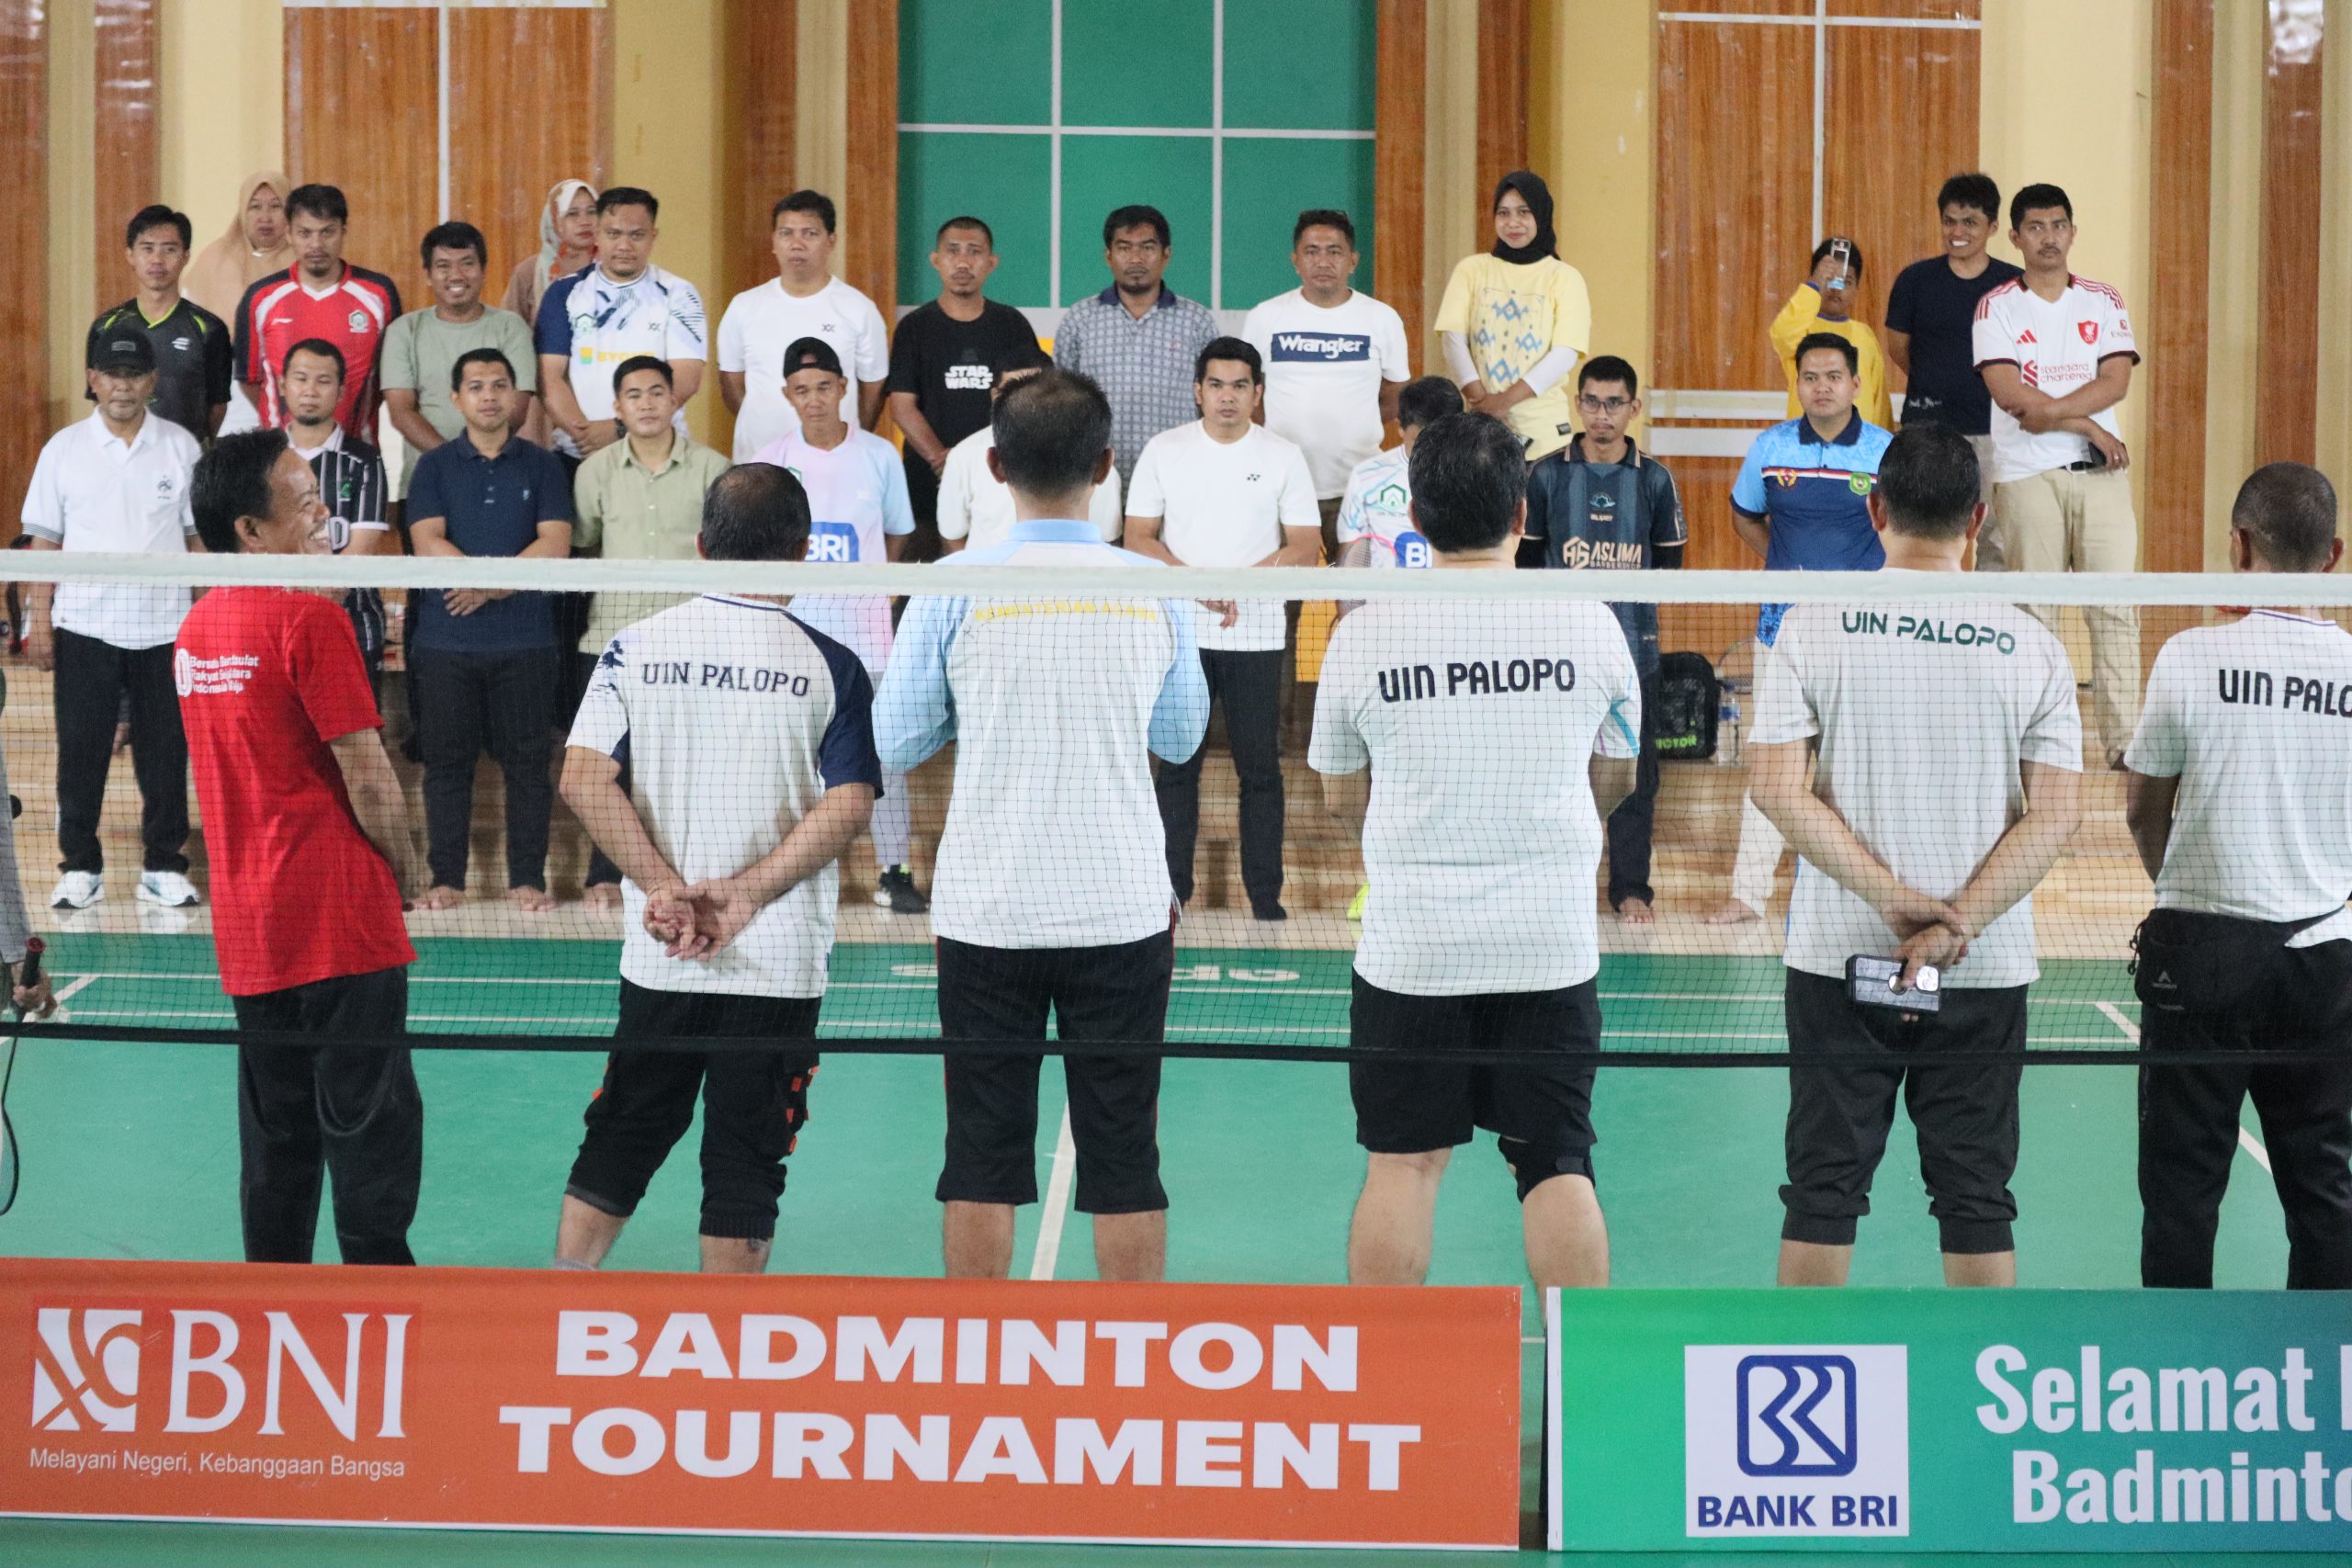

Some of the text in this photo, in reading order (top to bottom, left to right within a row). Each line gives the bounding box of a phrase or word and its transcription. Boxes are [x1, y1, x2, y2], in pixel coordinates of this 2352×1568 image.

[1277, 334, 1364, 359] Wrangler
[944, 366, 993, 378] STAR
[944, 378, 993, 389] WARS
[1590, 540, 1643, 562] ASLIMA
[1842, 611, 2016, 655] UIN PALOPO
[643, 662, 809, 696] UIN PALOPO
[1378, 659, 1576, 704] UIN PALOPO
[2219, 669, 2273, 706] UIN
[556, 1310, 1359, 1393] BADMINTON
[163, 1309, 413, 1442] BNI
[1975, 1345, 2315, 1434] Selamat
[29, 1448, 405, 1482] Melayani Negeri, Kebanggaan Bangsa
[499, 1405, 1421, 1492] TOURNAMENT
[1697, 1495, 1898, 1528] BANK BRI
